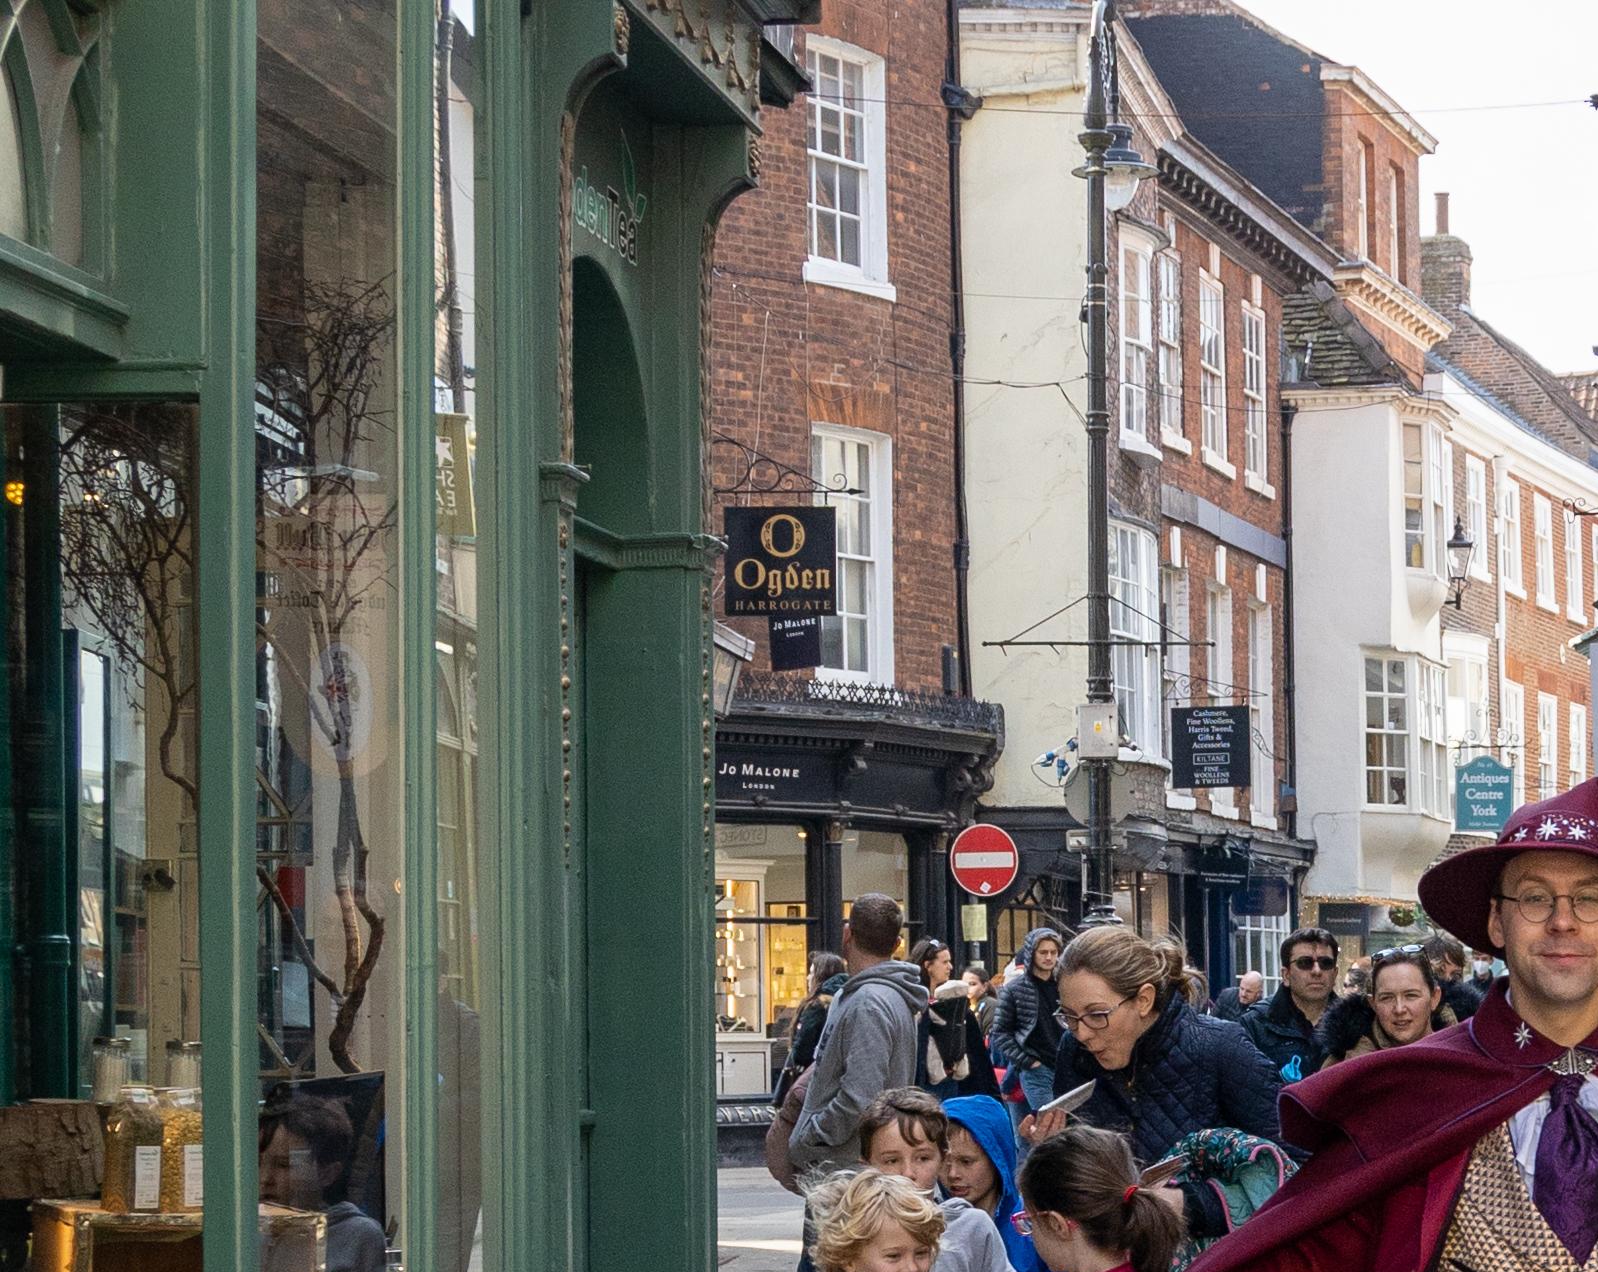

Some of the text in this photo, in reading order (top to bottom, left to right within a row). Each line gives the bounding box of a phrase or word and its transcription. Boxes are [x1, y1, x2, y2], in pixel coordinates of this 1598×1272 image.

[734, 558, 831, 598] Ogden
[735, 600, 831, 611] HARROGATE
[784, 617, 816, 629] MALONE
[1192, 741, 1230, 749] Accessories
[741, 763, 800, 778] MALONE
[1459, 772, 1509, 787] Antiques
[1465, 788, 1504, 800] Centre
[1470, 804, 1497, 816] York
